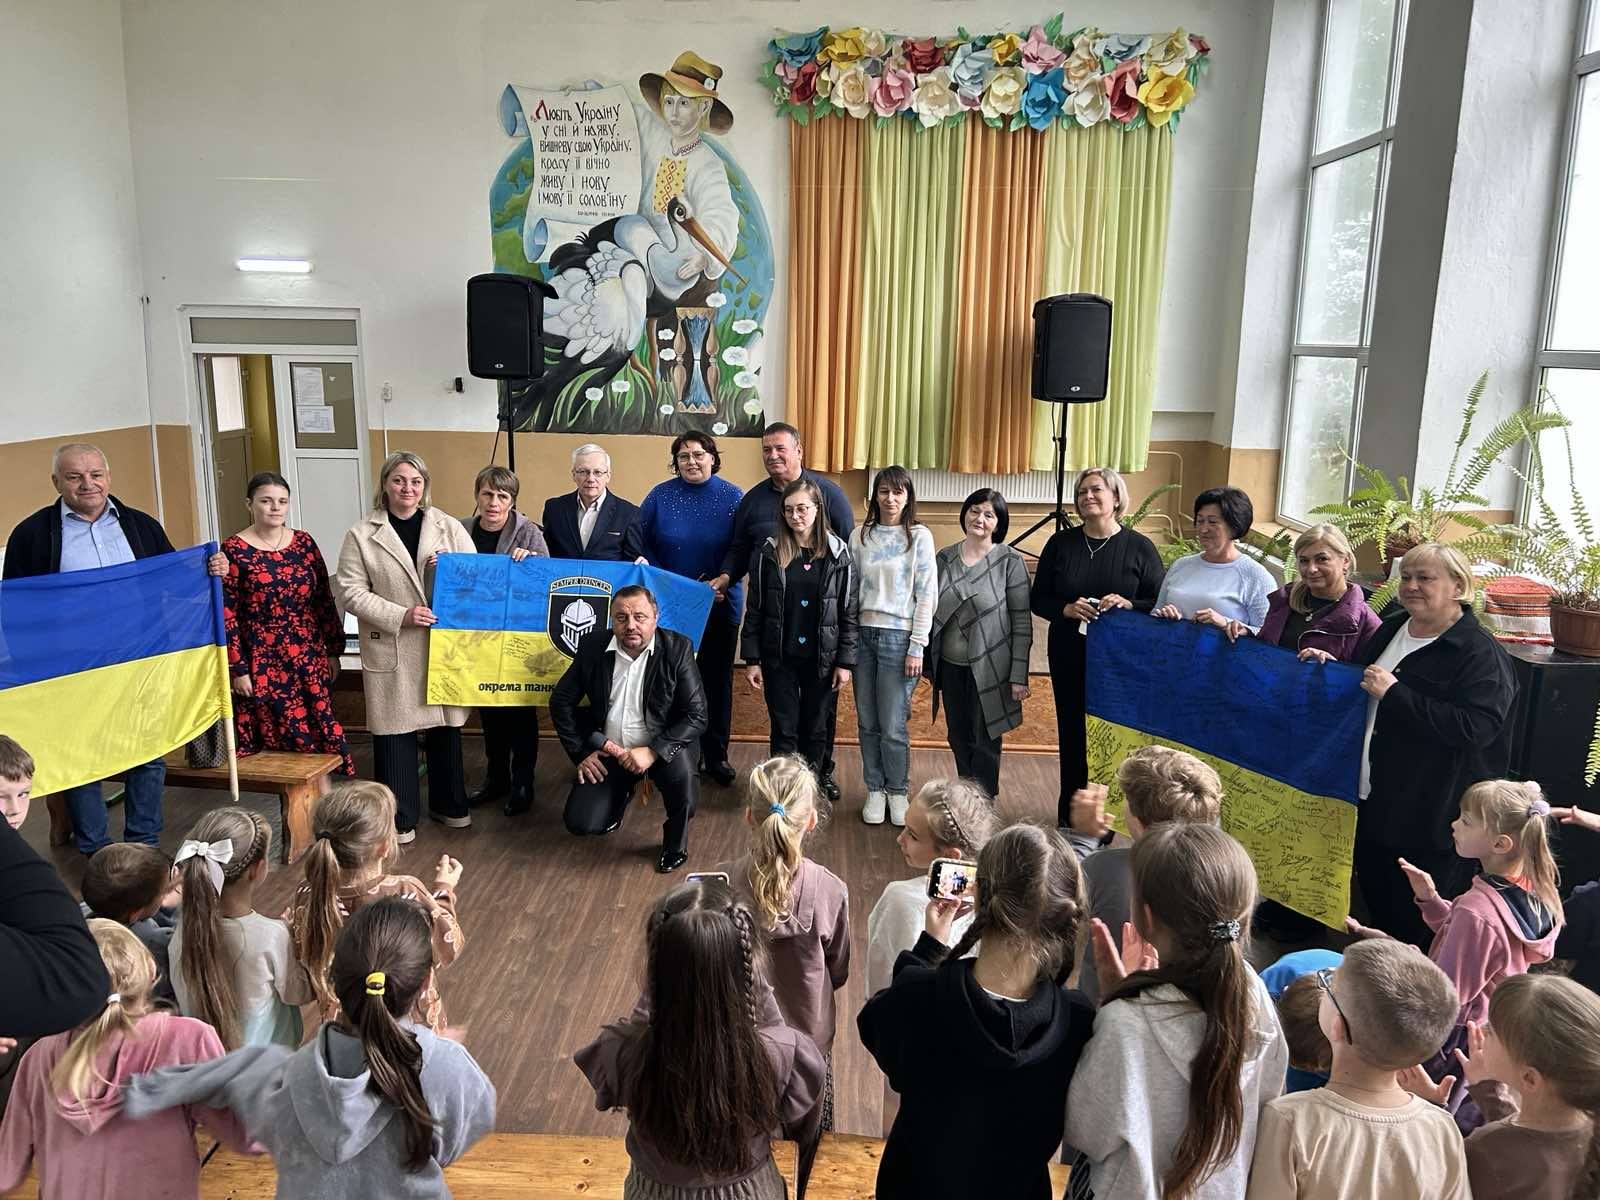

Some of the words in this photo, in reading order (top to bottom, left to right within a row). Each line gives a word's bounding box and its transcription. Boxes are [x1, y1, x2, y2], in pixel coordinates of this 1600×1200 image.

[575, 101, 621, 123] Україну
[582, 176, 610, 192] нову
[478, 683, 522, 693] окрема
